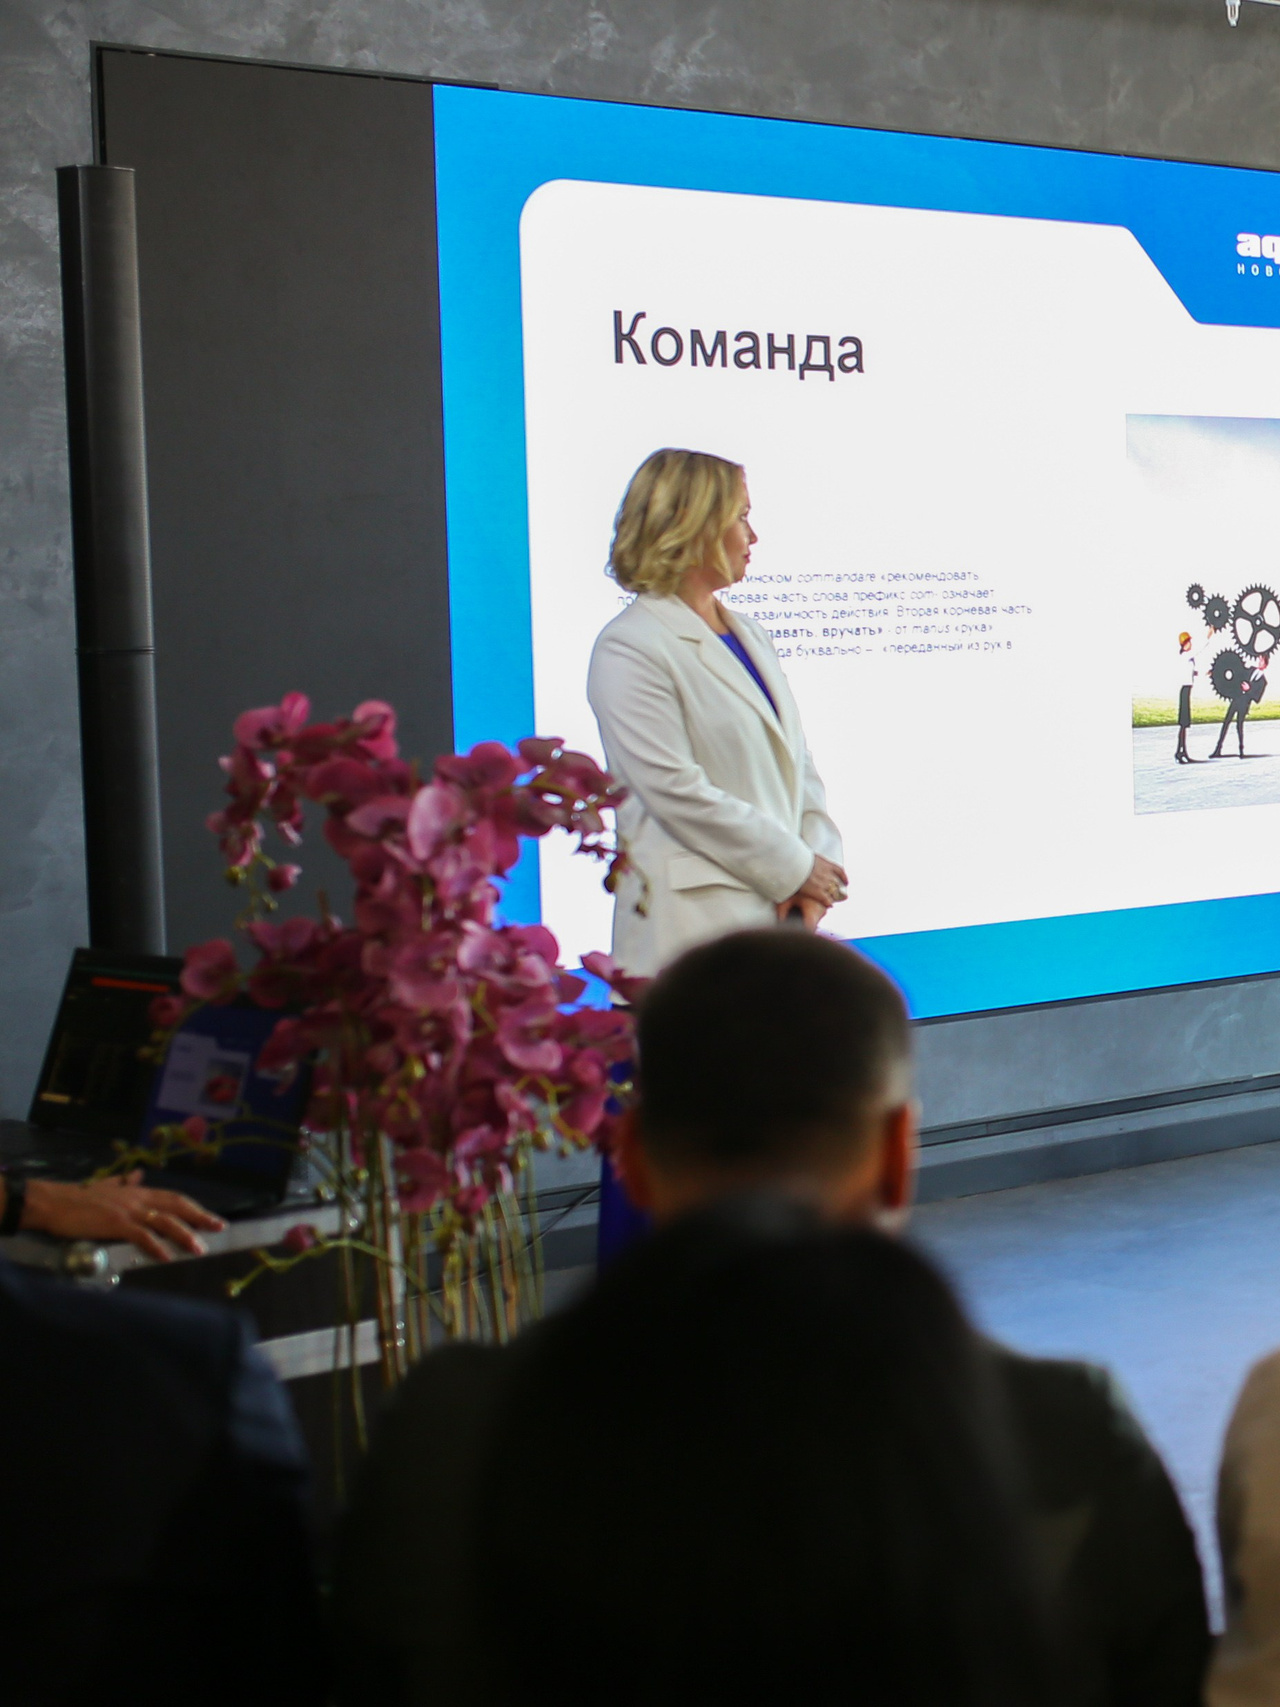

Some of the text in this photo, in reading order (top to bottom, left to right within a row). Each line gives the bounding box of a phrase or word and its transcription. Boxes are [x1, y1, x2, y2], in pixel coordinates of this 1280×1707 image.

[613, 309, 865, 382] Команда
[773, 593, 808, 603] часть
[812, 592, 849, 602] слова
[853, 591, 906, 602] префикс
[942, 589, 995, 599] означает
[896, 605, 939, 618] Вторая
[943, 606, 998, 617] корневая
[1001, 605, 1033, 615] часть
[895, 625, 907, 635] от
[912, 624, 950, 635] manus
[796, 644, 861, 660] буквально
[967, 642, 980, 651] из
[983, 641, 1002, 654] рук
[1006, 640, 1012, 650] в
